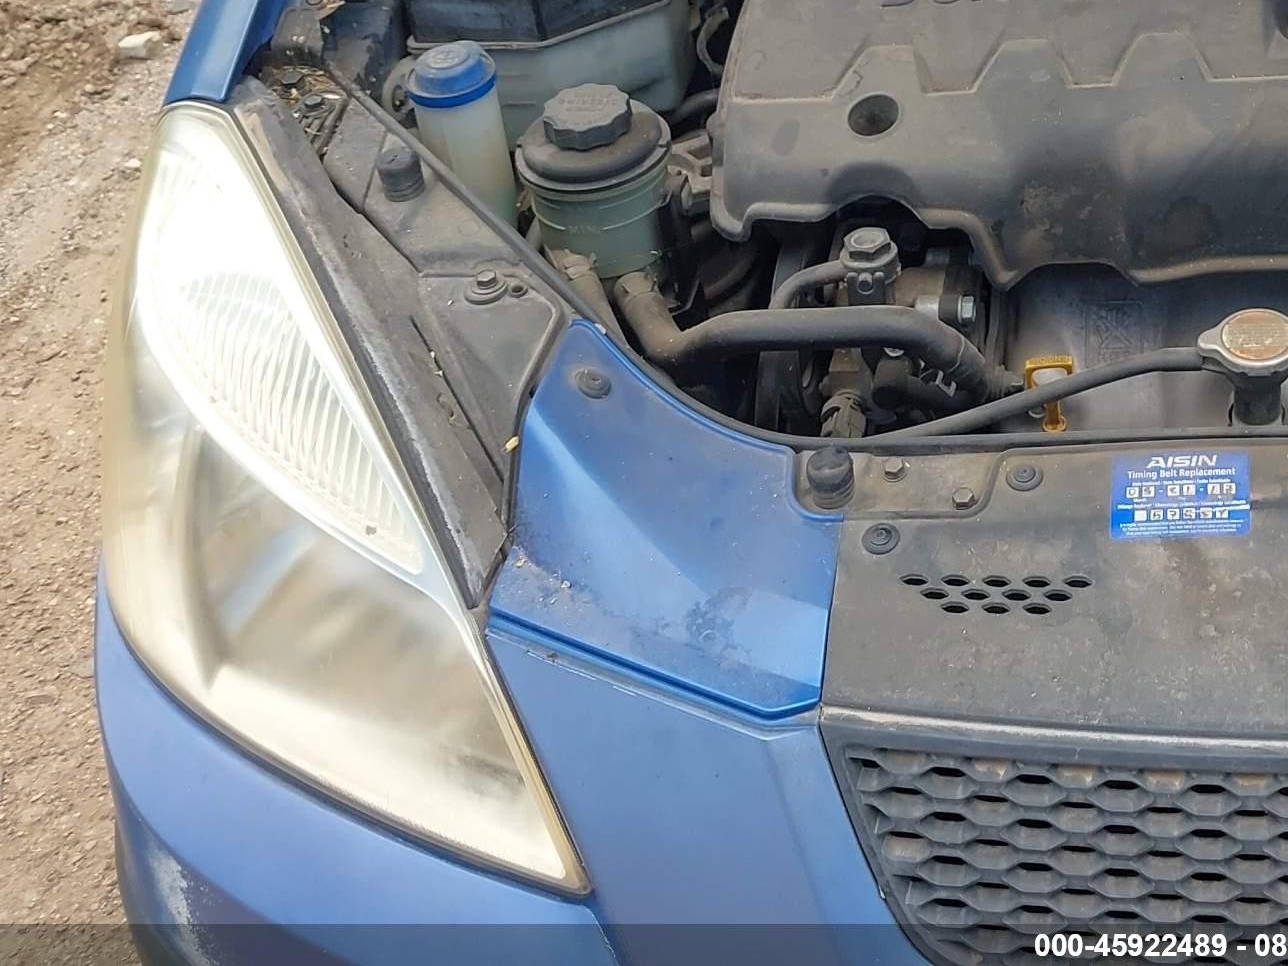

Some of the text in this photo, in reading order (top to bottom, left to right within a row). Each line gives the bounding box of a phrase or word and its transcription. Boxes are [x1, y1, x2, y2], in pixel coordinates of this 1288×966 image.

[1146, 455, 1217, 468] AISIN
[1127, 467, 1236, 480] Timing Belt Replacement
